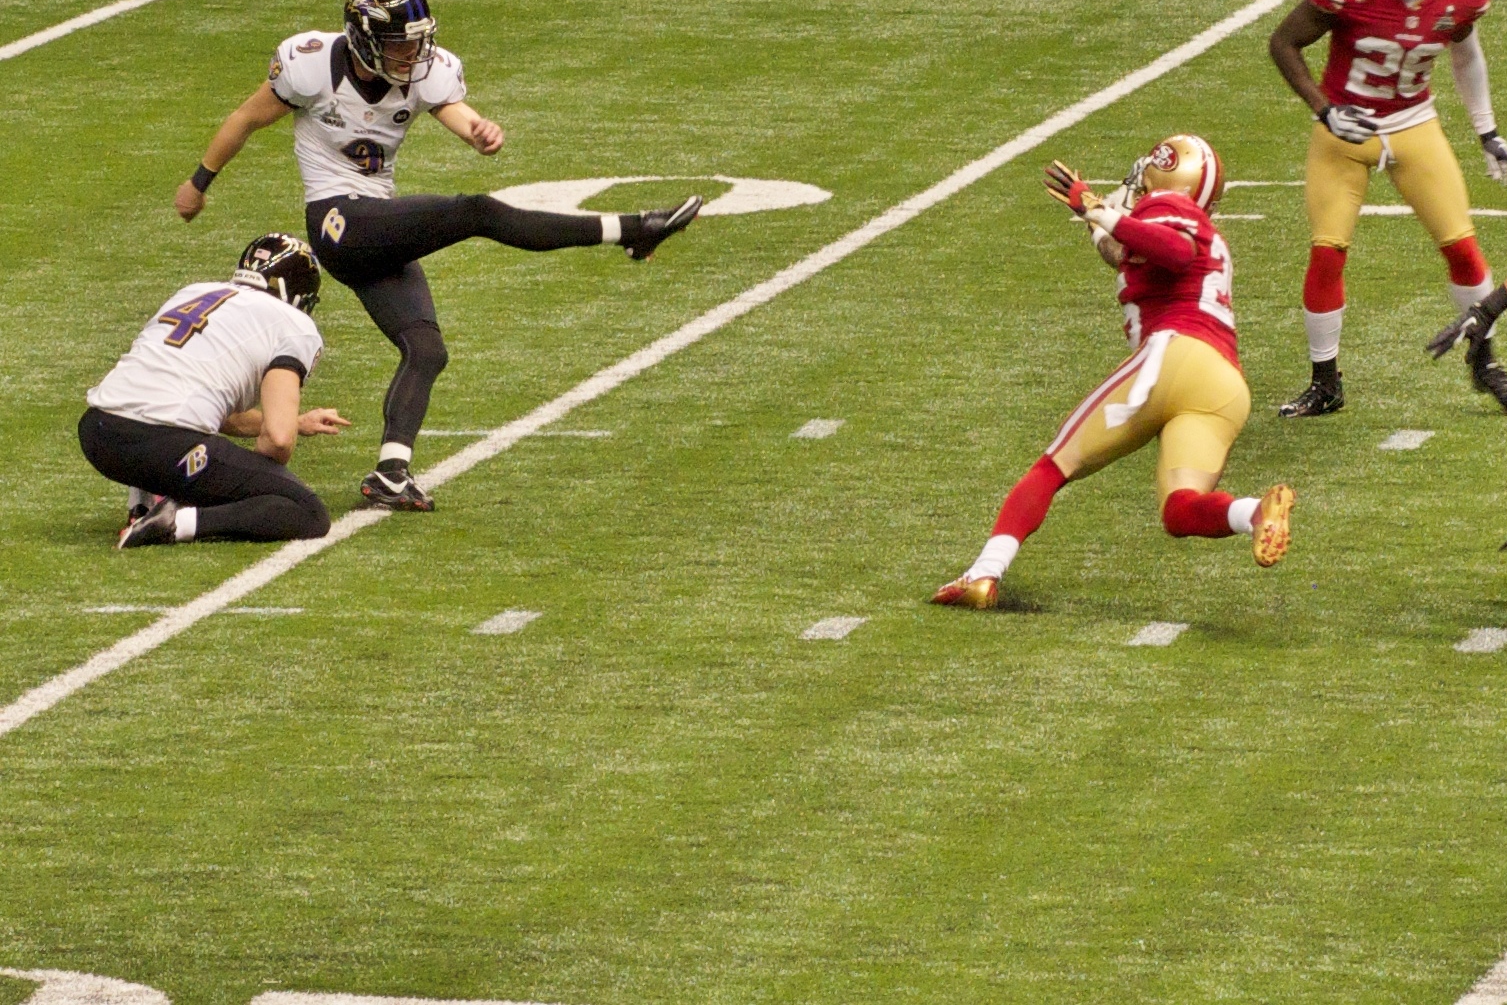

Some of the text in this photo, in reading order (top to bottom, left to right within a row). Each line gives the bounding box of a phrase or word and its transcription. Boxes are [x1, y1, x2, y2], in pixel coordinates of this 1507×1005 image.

[1344, 36, 1445, 101] 26
[321, 207, 347, 245] B
[158, 287, 240, 349] 4
[177, 443, 208, 477] B
